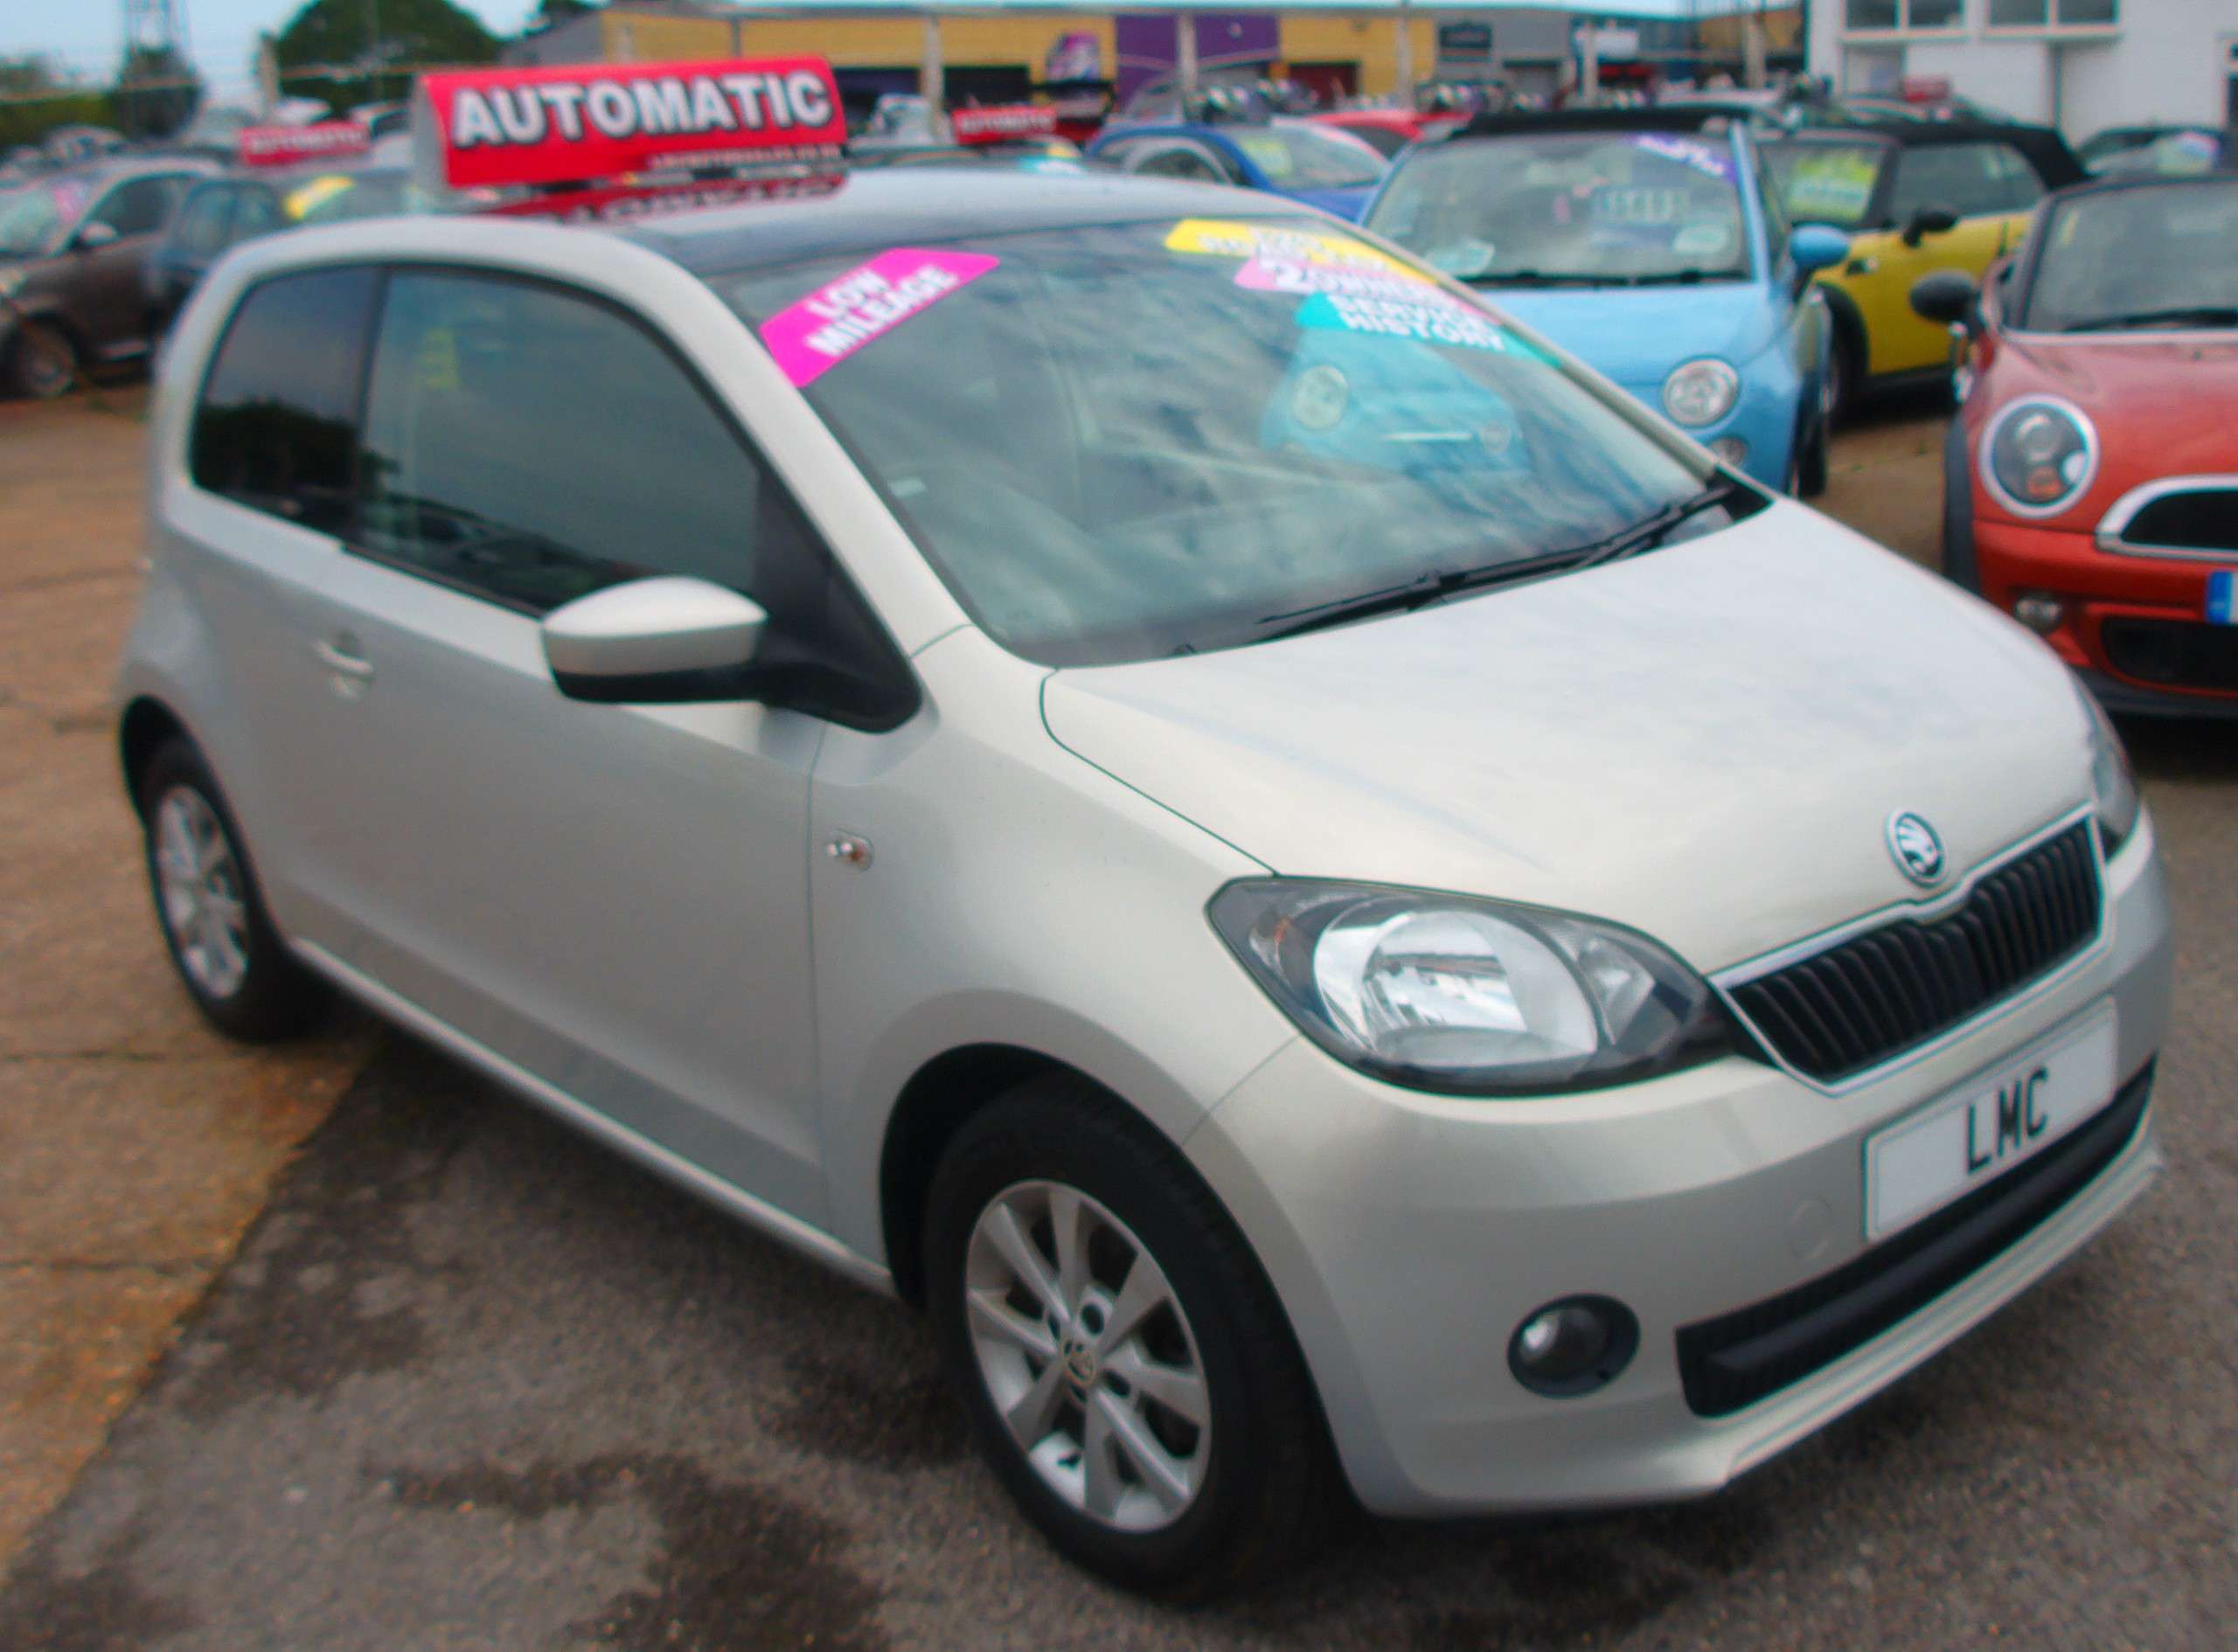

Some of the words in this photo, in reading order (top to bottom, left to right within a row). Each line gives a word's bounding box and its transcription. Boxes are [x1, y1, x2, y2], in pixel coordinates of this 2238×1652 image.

[452, 71, 831, 148] AUTOMATIC
[804, 263, 959, 357] MILEAGE
[806, 267, 890, 320] LOW
[1338, 307, 1506, 351] HISTORY
[1967, 1067, 2049, 1173] LMC
